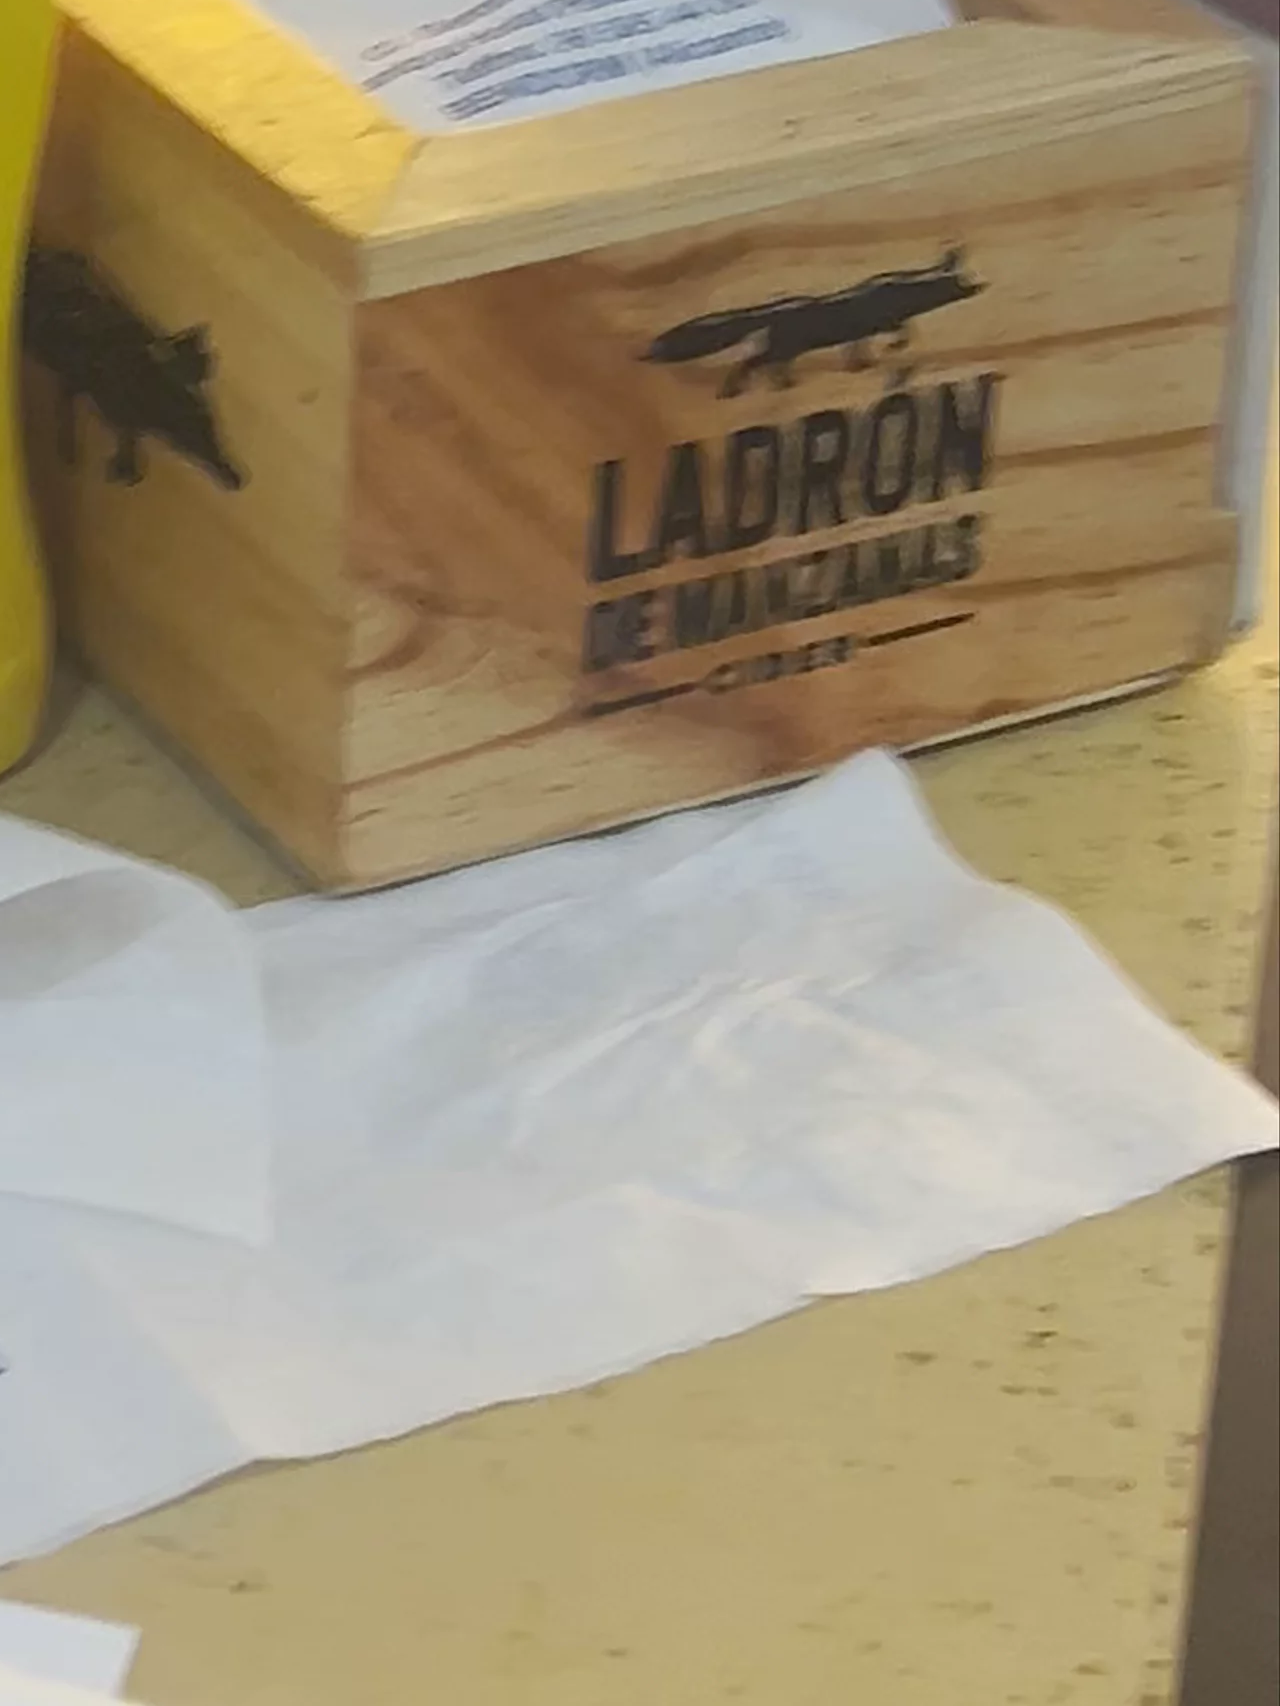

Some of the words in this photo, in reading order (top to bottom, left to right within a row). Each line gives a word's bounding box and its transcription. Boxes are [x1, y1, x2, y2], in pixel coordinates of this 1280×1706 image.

[587, 368, 1007, 583] LADRÓN
[583, 588, 656, 674] DE
[671, 513, 983, 650] MANZANAS
